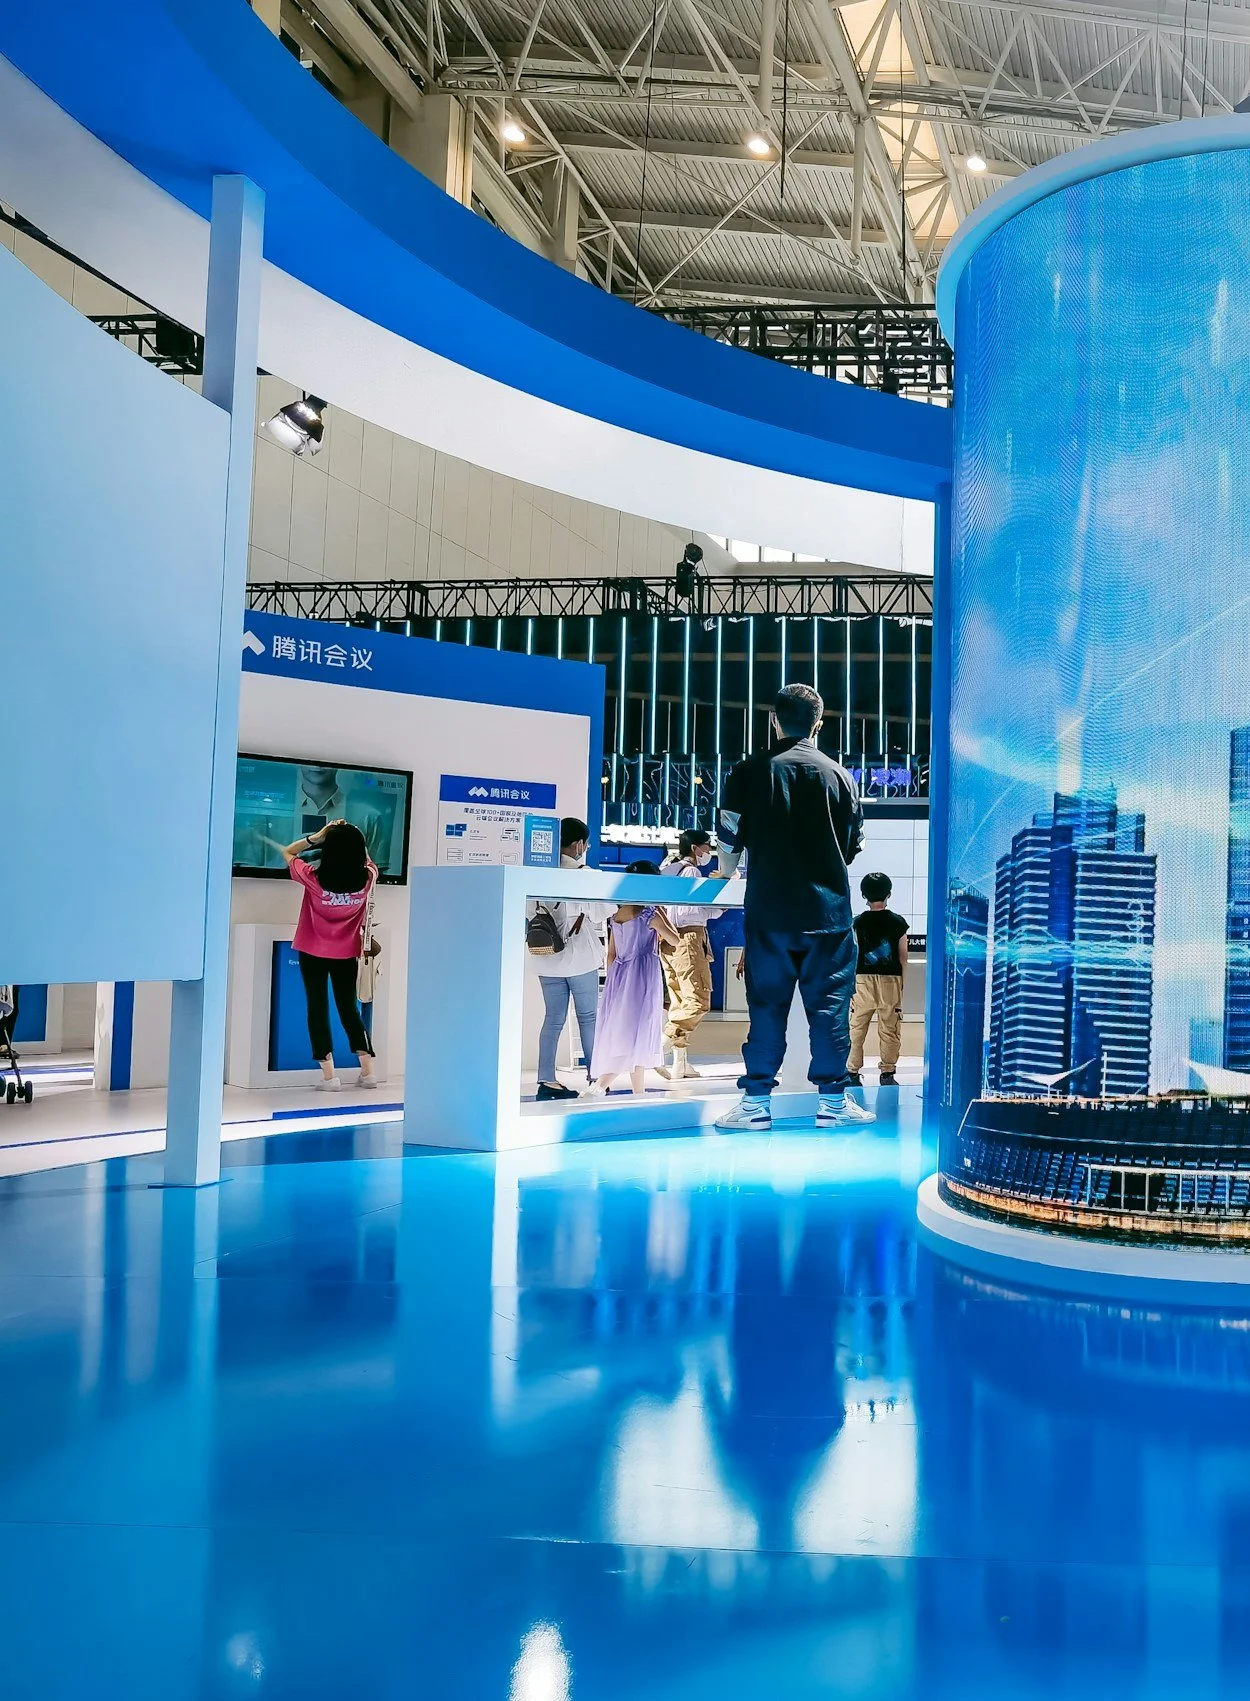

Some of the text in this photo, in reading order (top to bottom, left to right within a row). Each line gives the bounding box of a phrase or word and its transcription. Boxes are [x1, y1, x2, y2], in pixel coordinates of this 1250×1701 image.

[271, 635, 373, 672] 腾讯会议
[490, 787, 530, 801] 腾讯会议
